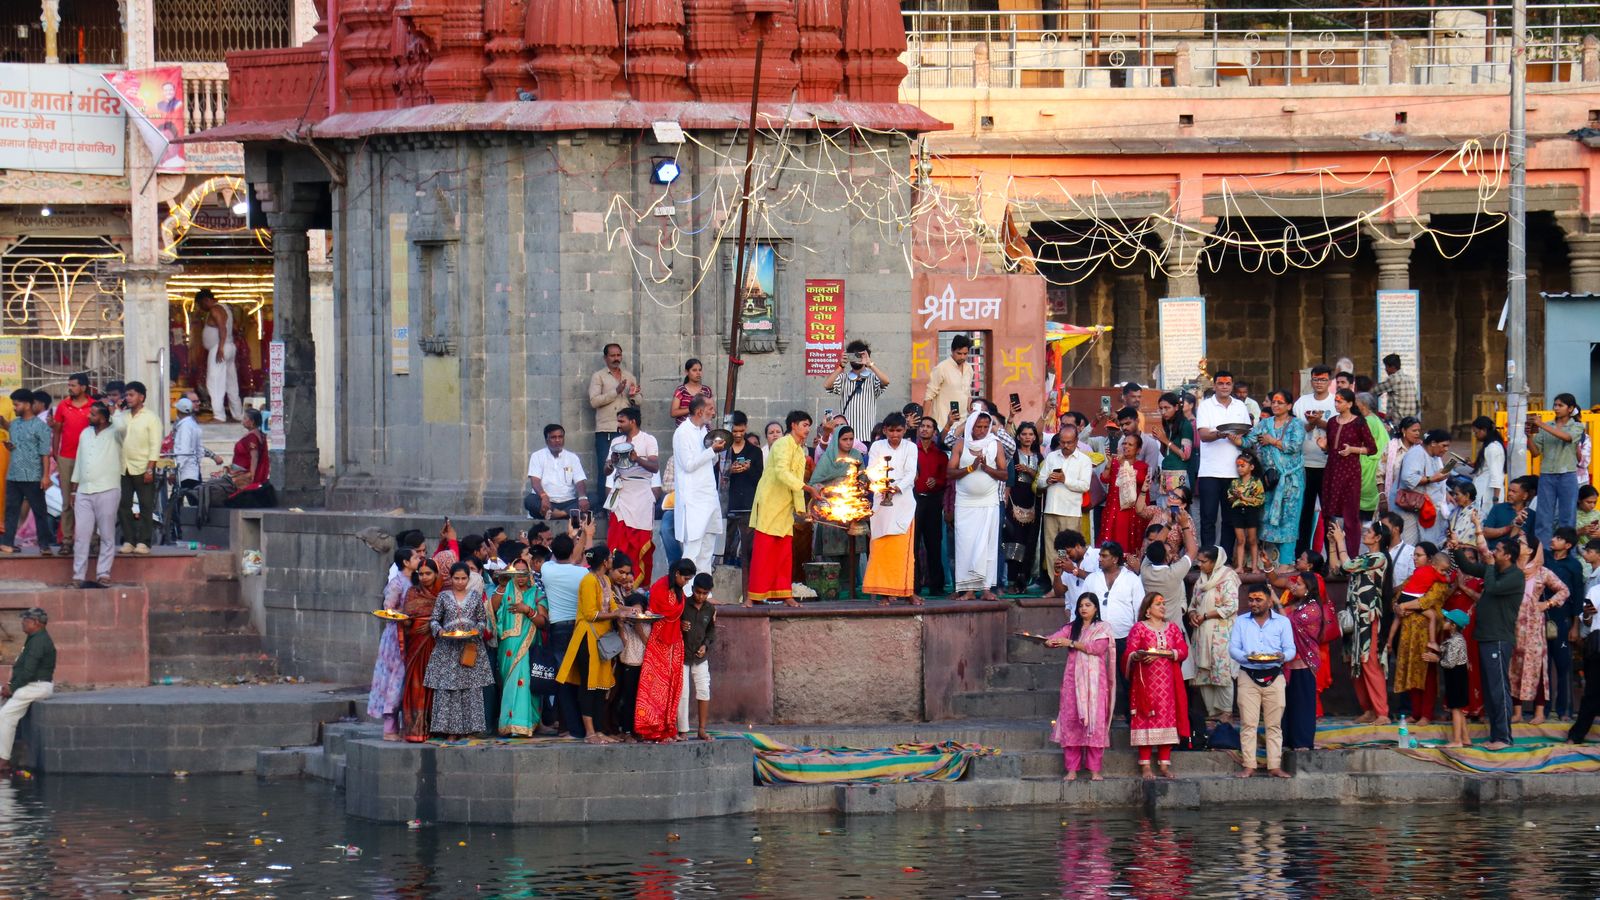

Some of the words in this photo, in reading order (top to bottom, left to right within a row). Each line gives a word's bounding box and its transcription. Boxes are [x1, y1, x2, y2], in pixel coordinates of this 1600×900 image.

[31, 92, 73, 112] माता
[78, 87, 122, 114] मंदिर
[22, 114, 56, 131] उज्जैन
[807, 285, 840, 294] कालसर्प
[813, 294, 833, 302] दोष
[809, 303, 837, 312] मंगल
[918, 283, 957, 329] श्री
[959, 298, 1002, 320] राम
[814, 312, 832, 320] दोष
[811, 332, 836, 340] दोष
